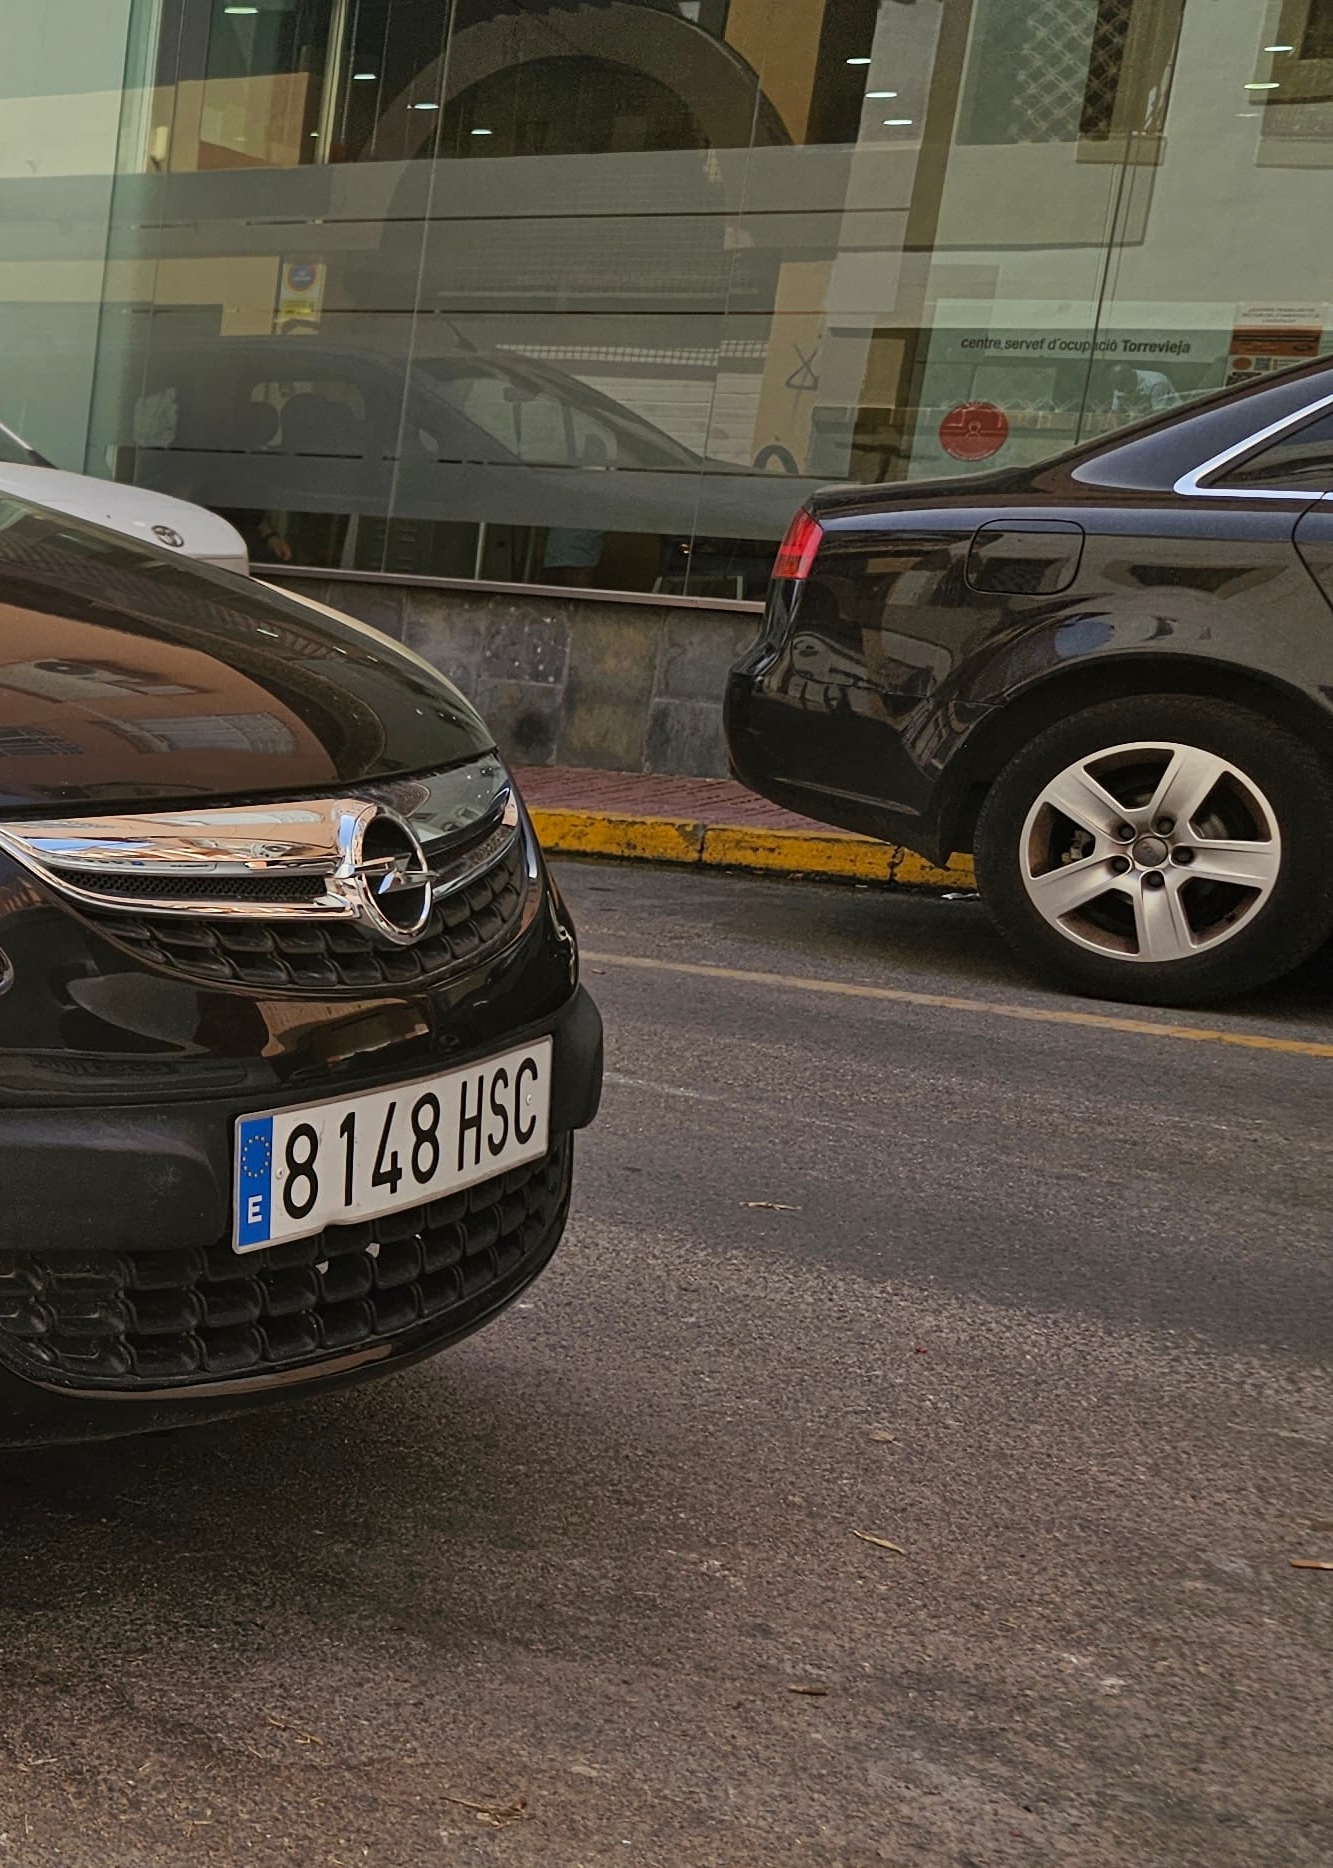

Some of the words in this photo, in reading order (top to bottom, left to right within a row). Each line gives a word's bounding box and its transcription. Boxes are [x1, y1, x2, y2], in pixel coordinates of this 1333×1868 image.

[961, 336, 1001, 350] centre
[1004, 338, 1045, 350] servef
[1121, 339, 1191, 356] Torrevieja
[282, 1092, 440, 1219] 8148
[456, 1056, 539, 1173] HSC
[246, 1194, 264, 1225] E
